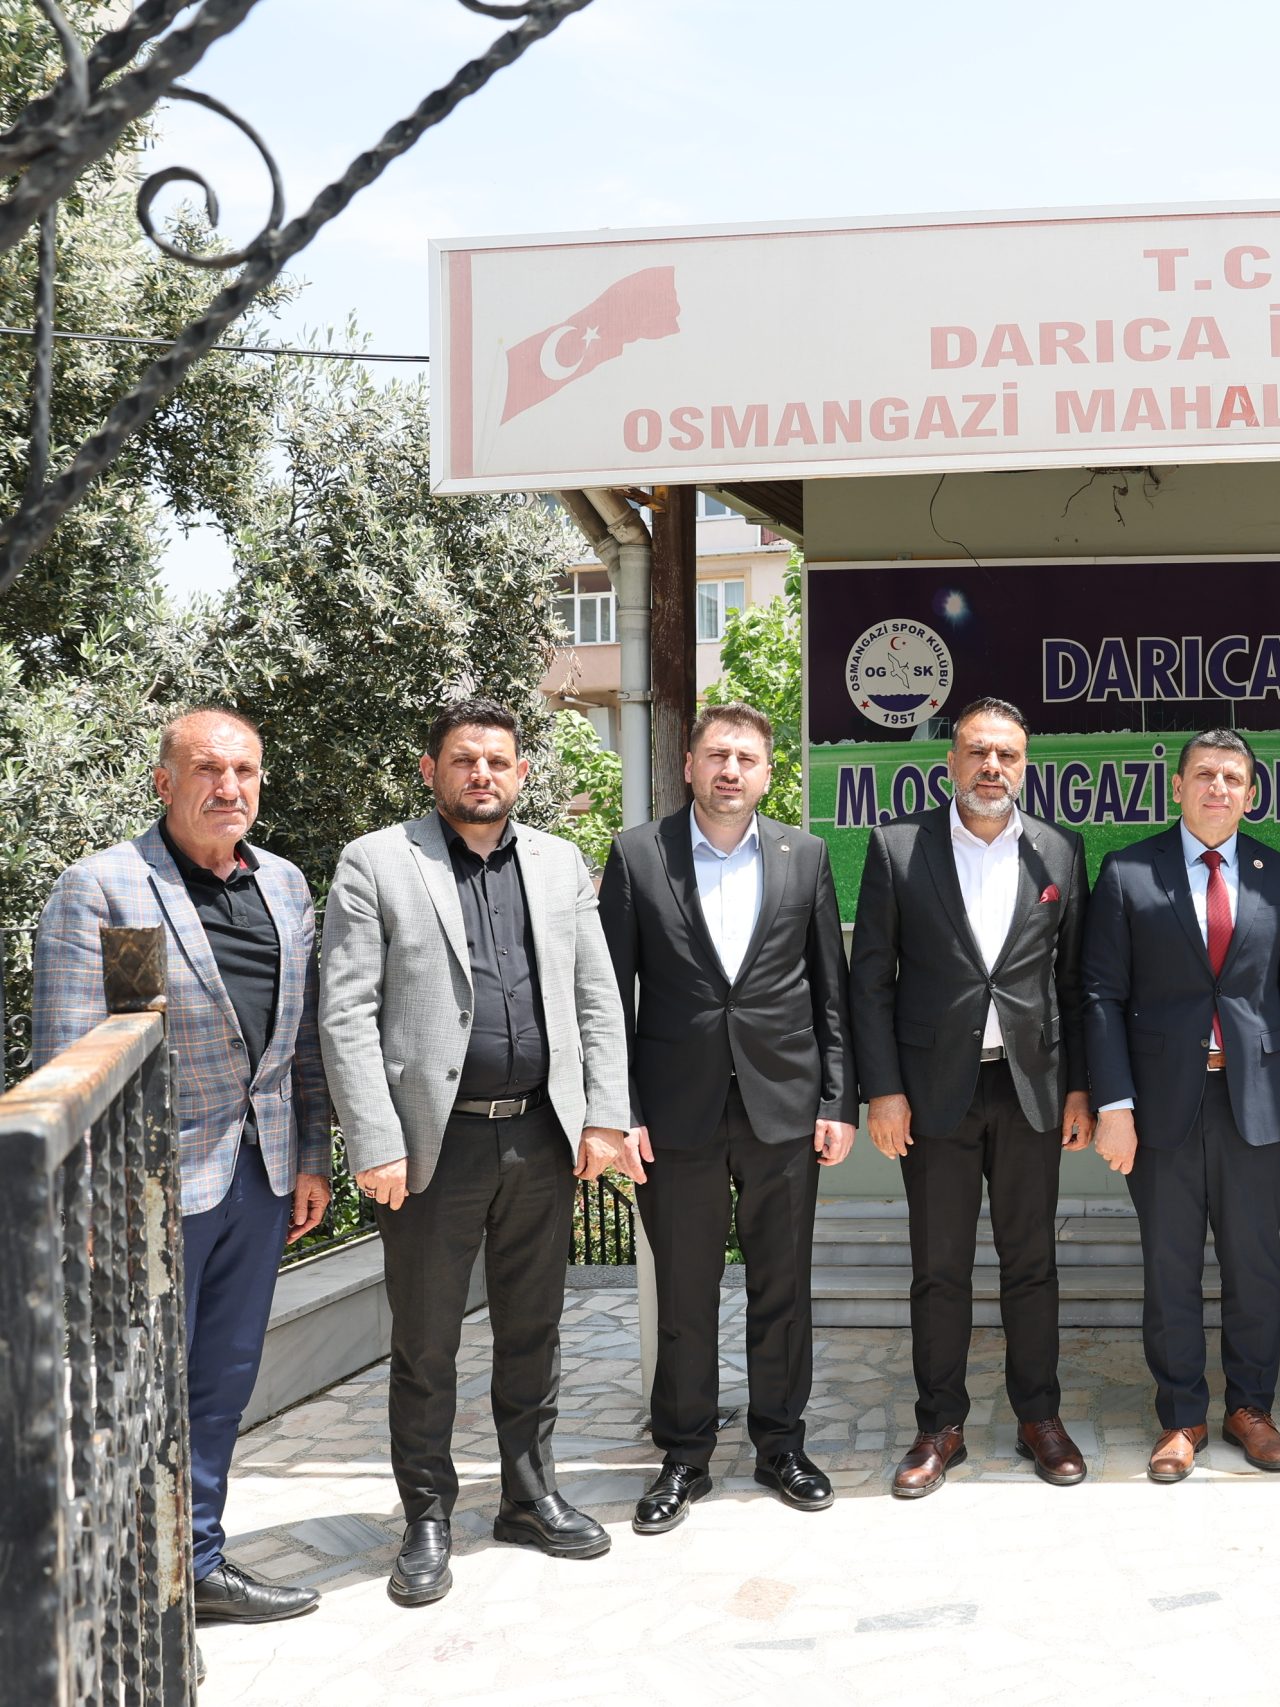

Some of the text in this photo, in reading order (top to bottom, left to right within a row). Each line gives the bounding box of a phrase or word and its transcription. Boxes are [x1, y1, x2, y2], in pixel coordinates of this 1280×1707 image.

[930, 315, 1230, 369] DARICA
[623, 381, 1020, 454] OSMANGAZİ
[850, 623, 949, 692] OSMANGAZİ SPOR KULÜBÜ
[865, 665, 934, 678] OG SK
[883, 712, 916, 725] 1957
[834, 743, 1168, 829] M.OSNGAZİ
